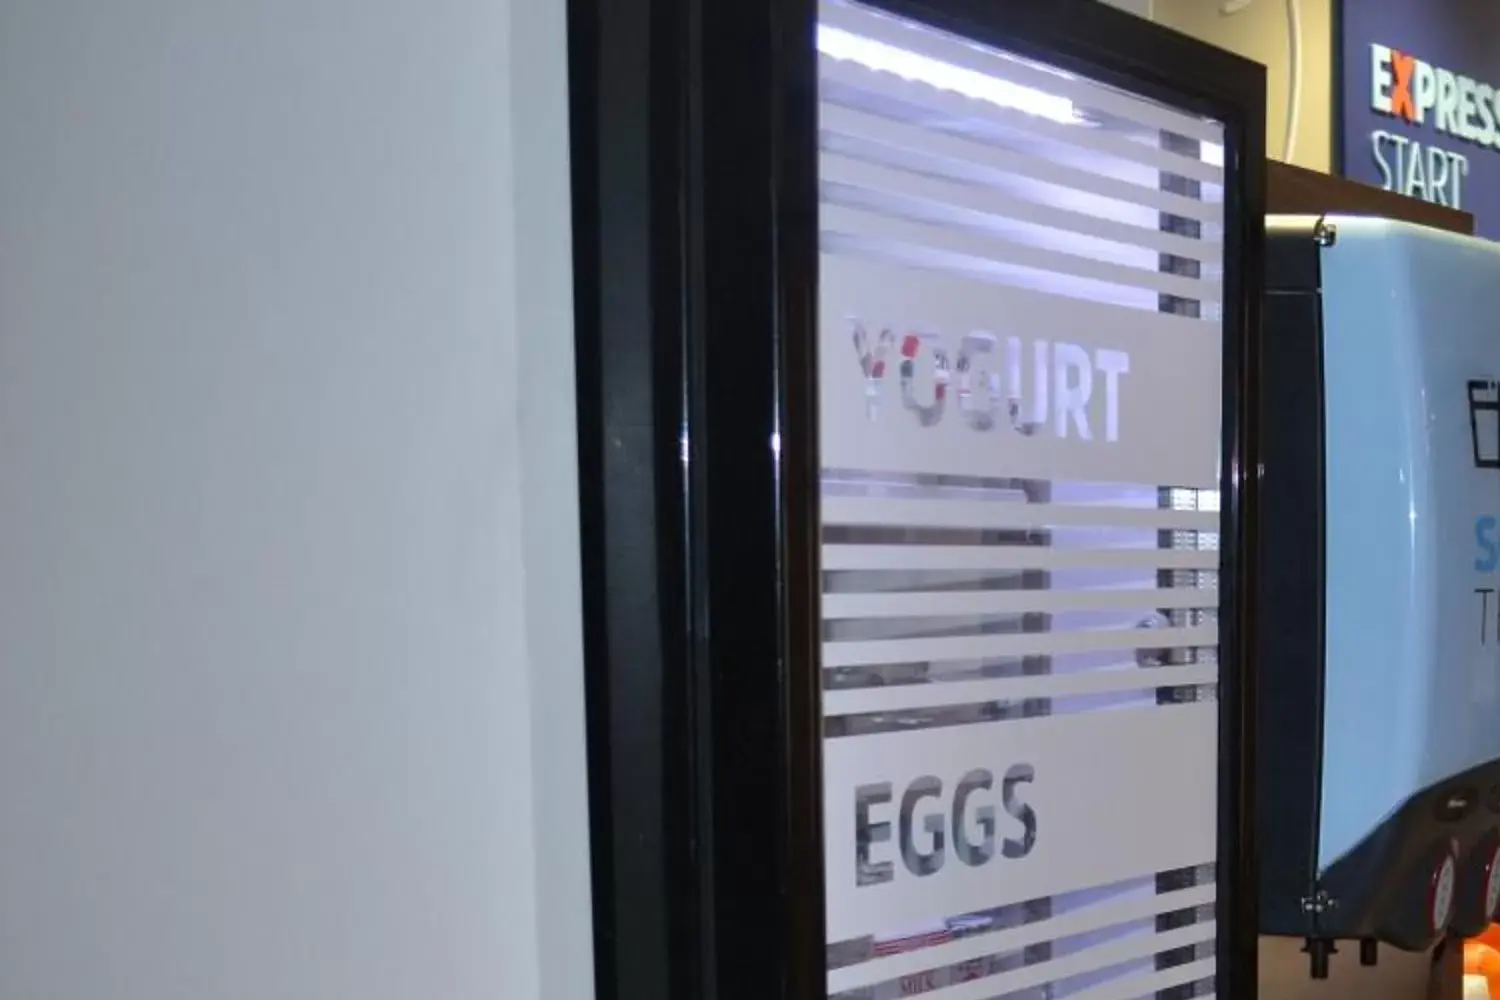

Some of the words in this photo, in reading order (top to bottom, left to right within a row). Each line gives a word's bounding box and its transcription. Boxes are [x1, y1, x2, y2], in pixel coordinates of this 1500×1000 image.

[1372, 130, 1468, 210] START
[847, 314, 1130, 442] YOGURT
[855, 762, 1037, 888] EGGS
